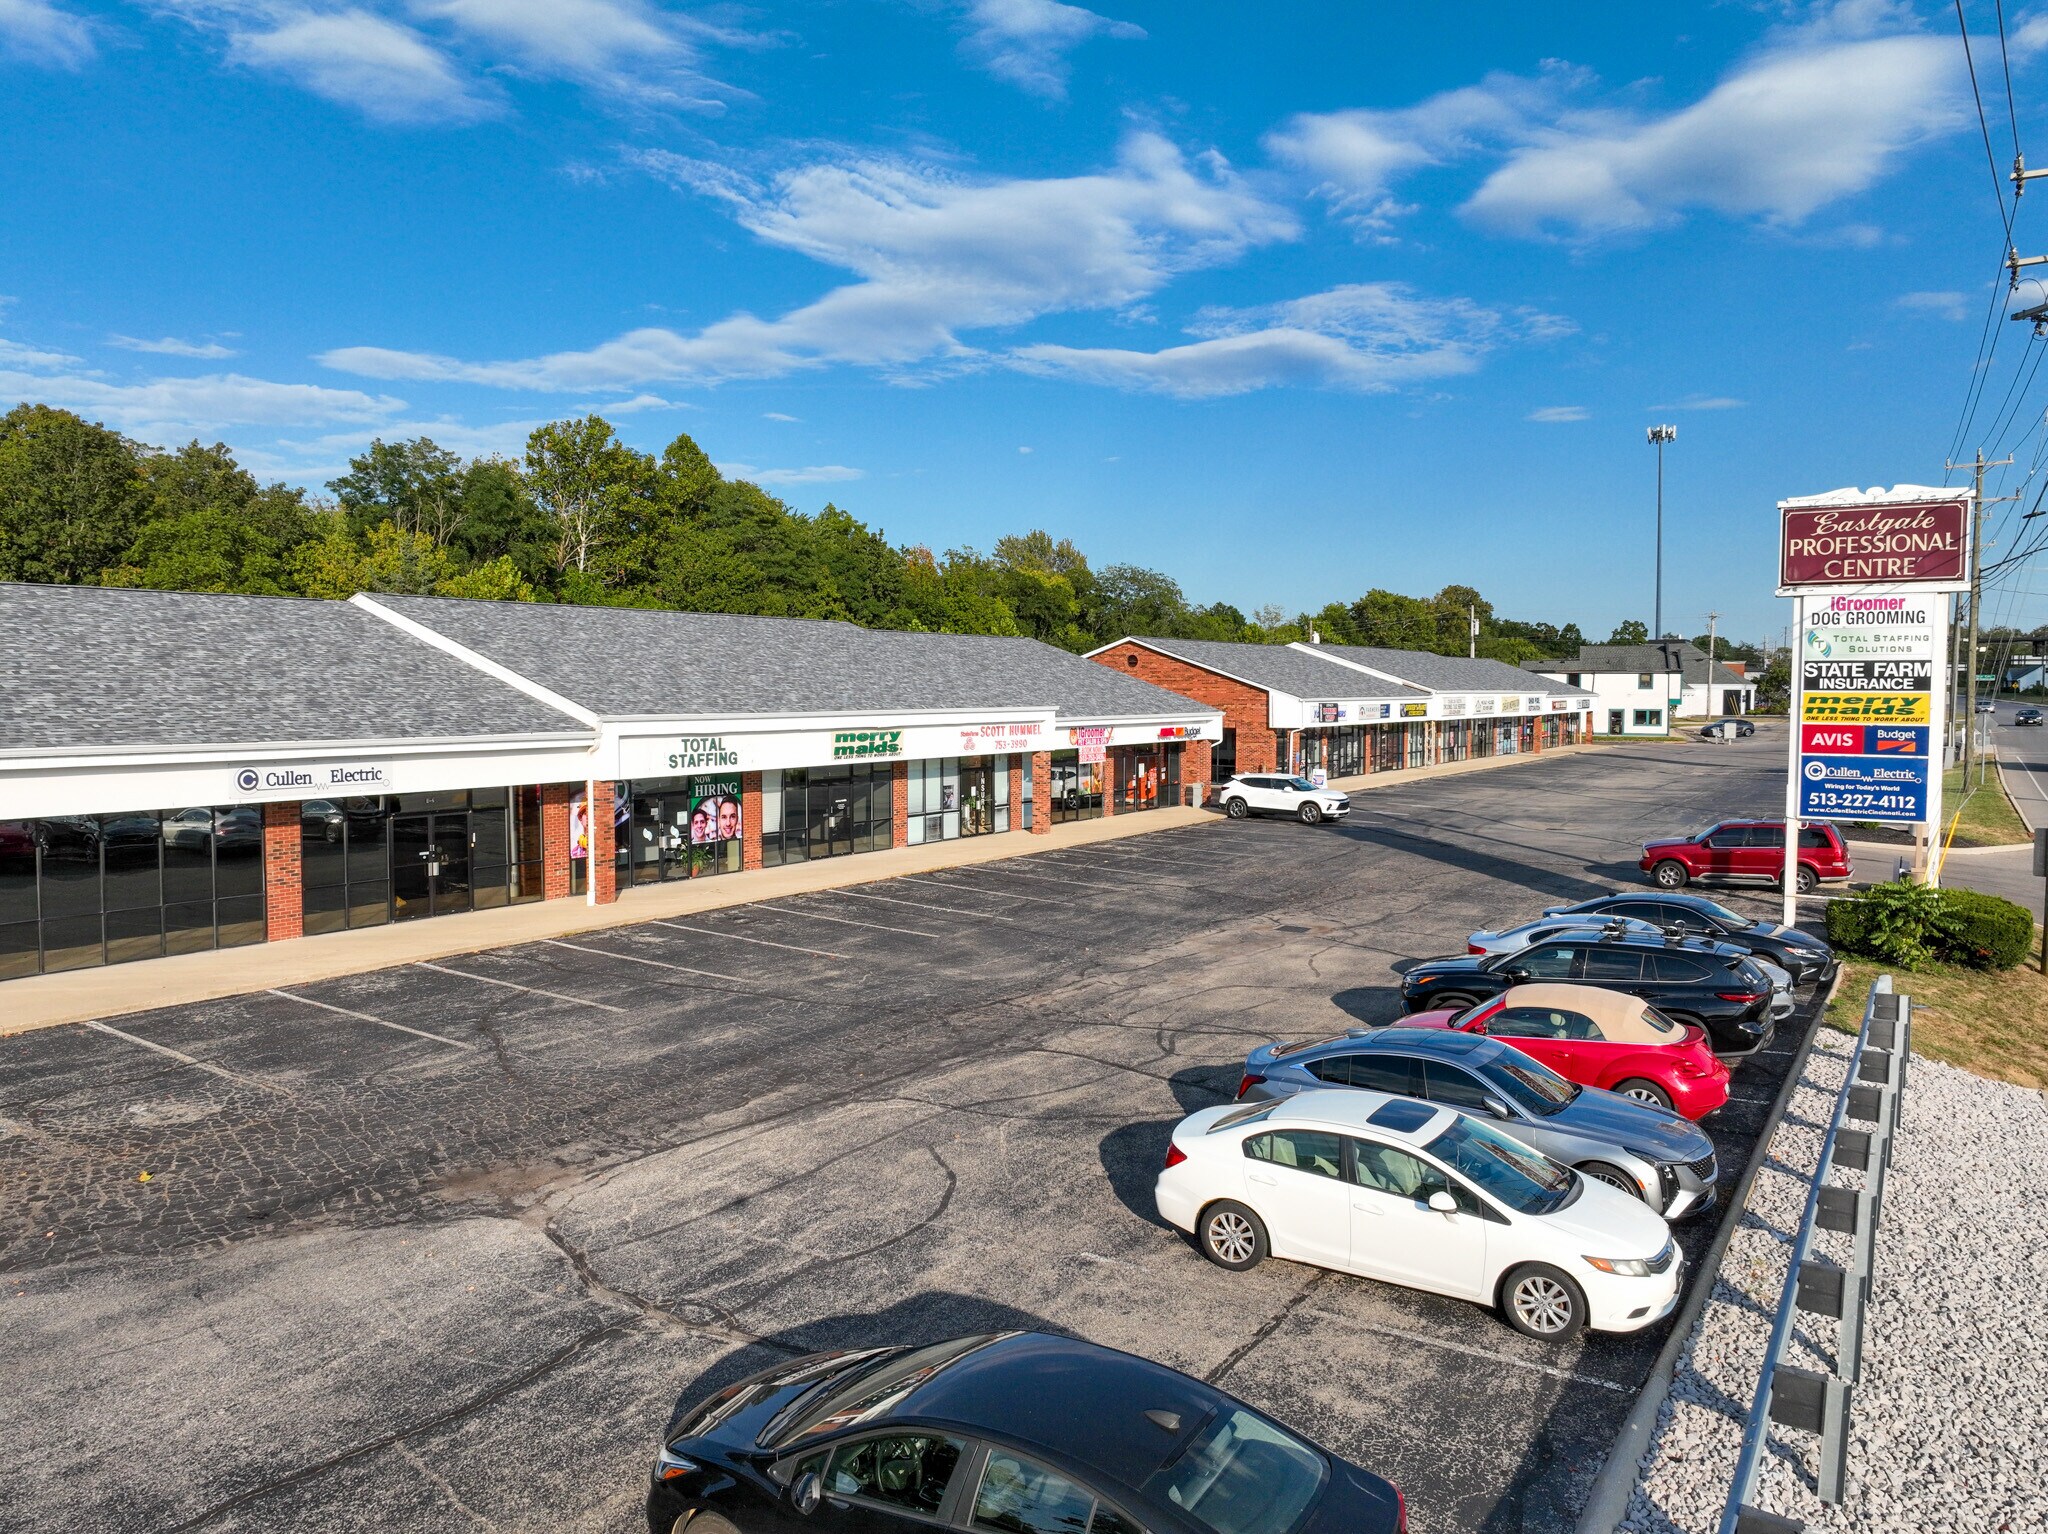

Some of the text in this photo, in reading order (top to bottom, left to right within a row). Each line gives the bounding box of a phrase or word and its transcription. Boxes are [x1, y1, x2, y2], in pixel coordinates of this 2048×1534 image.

[1811, 510, 1935, 536] Eastgate
[1789, 532, 1958, 557] PROFESSIONAL
[1831, 596, 1906, 611] iGroomer
[1811, 610, 1926, 626] DOG GROOMING
[1833, 634, 1930, 643] TOTAL STAFFING
[1849, 645, 1912, 653] SOLUTIONS
[1804, 662, 1931, 677] STATE FARM
[1819, 678, 1914, 690] INSURANCE
[1808, 697, 1922, 707] merry
[1804, 705, 1915, 715] maids
[835, 731, 902, 743] merry
[980, 724, 1041, 737] SCOTT HUMMEL
[1184, 727, 1201, 738] Budget
[995, 739, 1028, 750] 753-3990
[1811, 730, 1916, 746] AVIS Budget
[681, 737, 726, 753] TOTAL
[834, 741, 899, 756] maids
[668, 752, 738, 769] STAFFING
[266, 771, 313, 787] Cullen
[330, 767, 383, 783] Electric
[1826, 767, 1861, 778] Cullen
[1873, 768, 1915, 779] Electric
[694, 776, 712, 784] NOW
[694, 782, 738, 797] HIRING
[1824, 783, 1844, 791] Wiring
[1856, 784, 1880, 792] Today's
[1808, 792, 1916, 809] 513-227-4112
[1808, 807, 1916, 817] www.CullenElectricCincinnati.com
